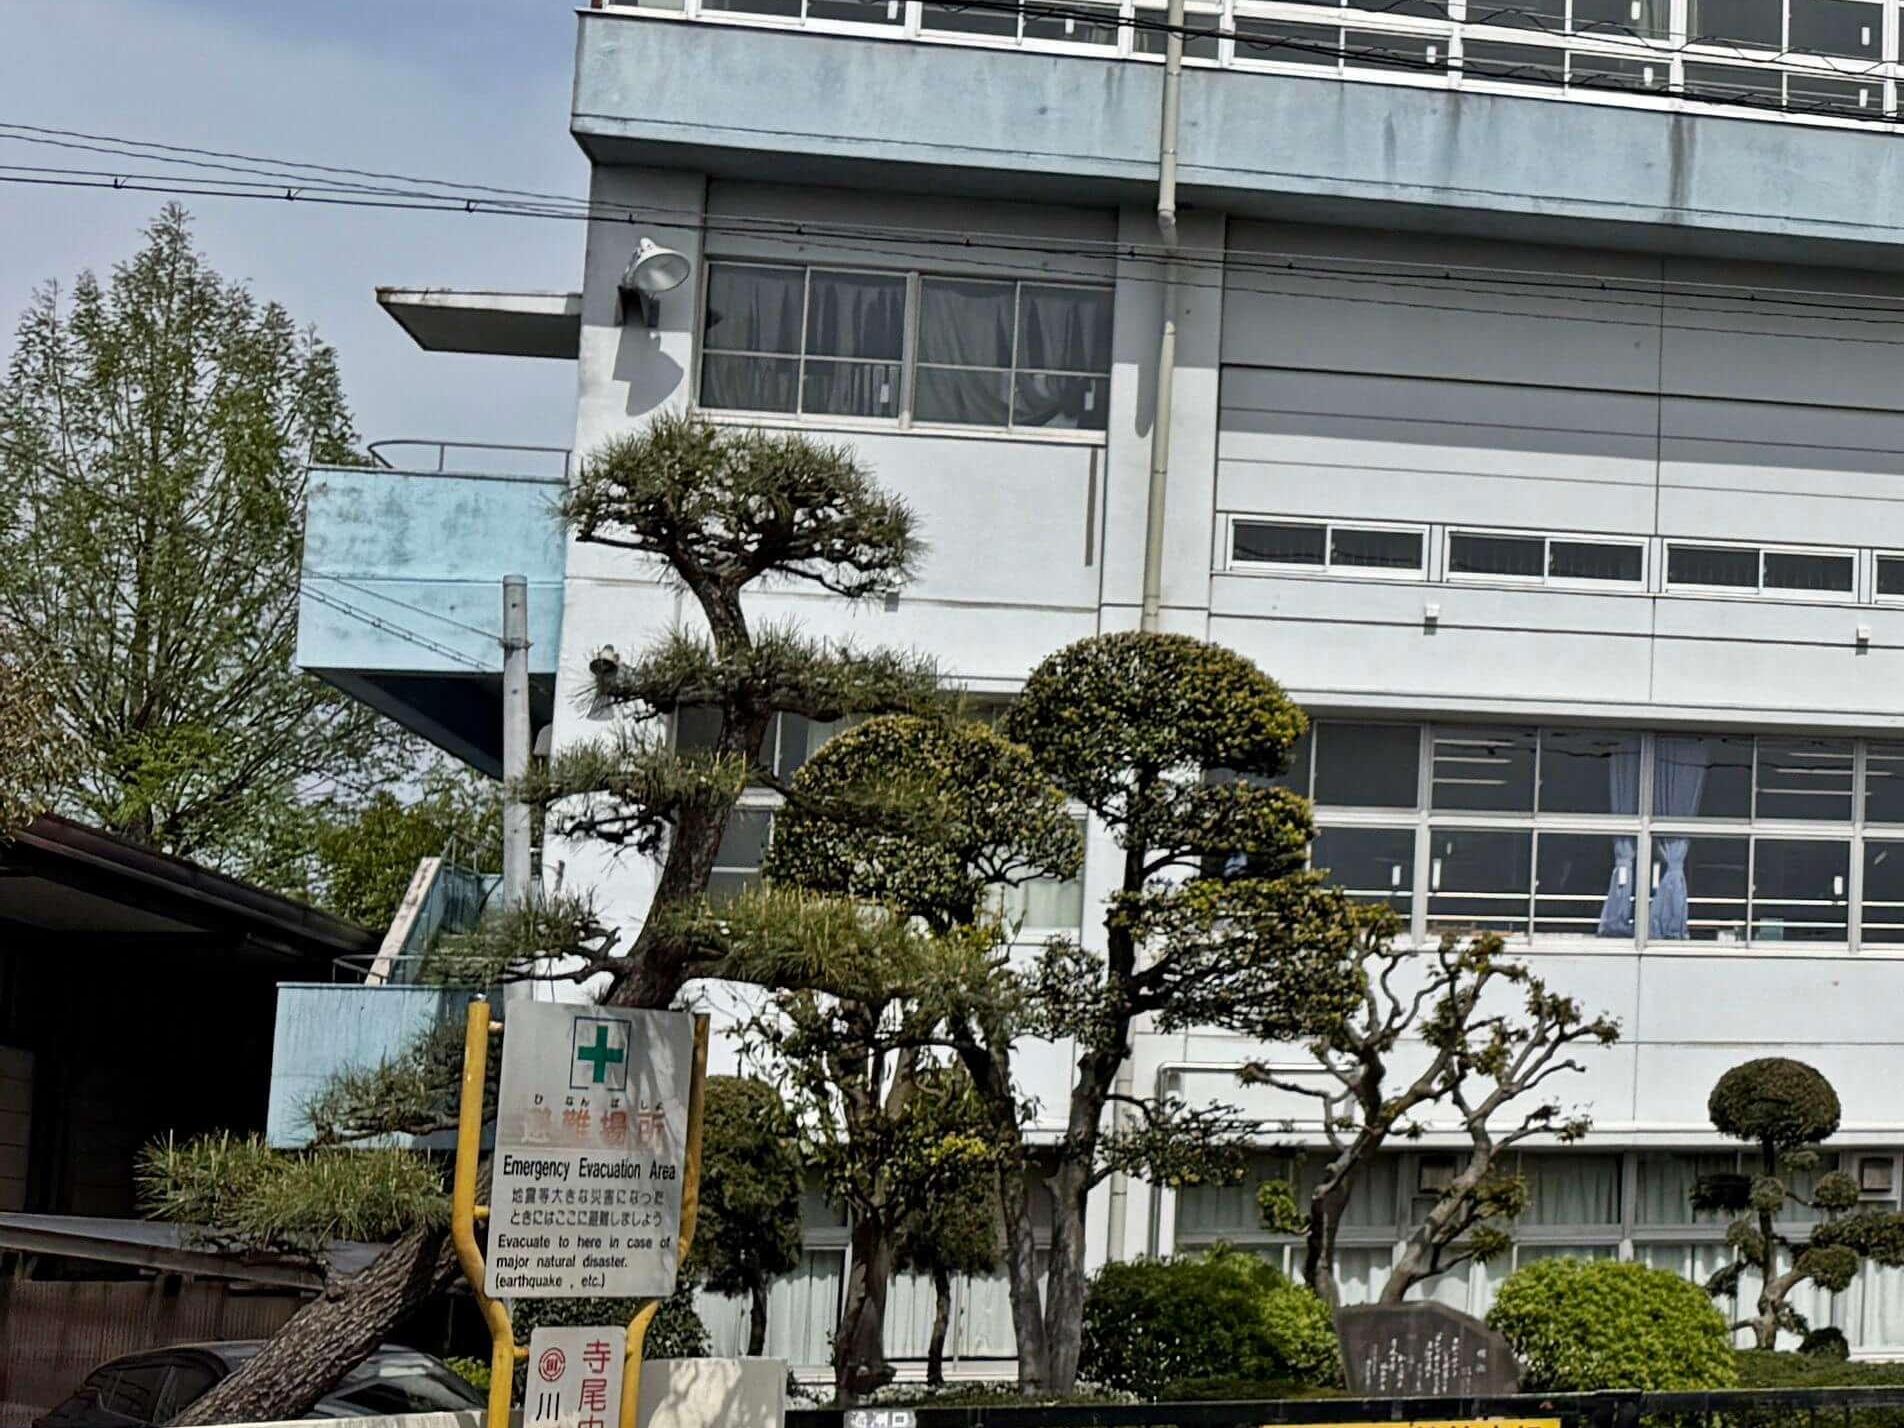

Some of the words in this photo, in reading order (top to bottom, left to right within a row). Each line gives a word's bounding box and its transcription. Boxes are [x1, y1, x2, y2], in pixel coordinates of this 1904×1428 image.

[503, 1155, 571, 1181] Emergency
[578, 1157, 641, 1181] Evacuation
[649, 1159, 676, 1181] Area
[511, 1187, 665, 1205] 地震等大きな災害になった
[510, 1209, 663, 1228] ときにはここに避難しましょう
[498, 1234, 550, 1249] Evacuate
[558, 1235, 570, 1249] to
[577, 1235, 602, 1249] here
[609, 1235, 619, 1249] in
[627, 1237, 653, 1249] case
[659, 1236, 671, 1249] of
[496, 1255, 530, 1270] major
[536, 1255, 576, 1268] natural
[582, 1255, 628, 1268] disaster.
[581, 1273, 606, 1289] etc.)
